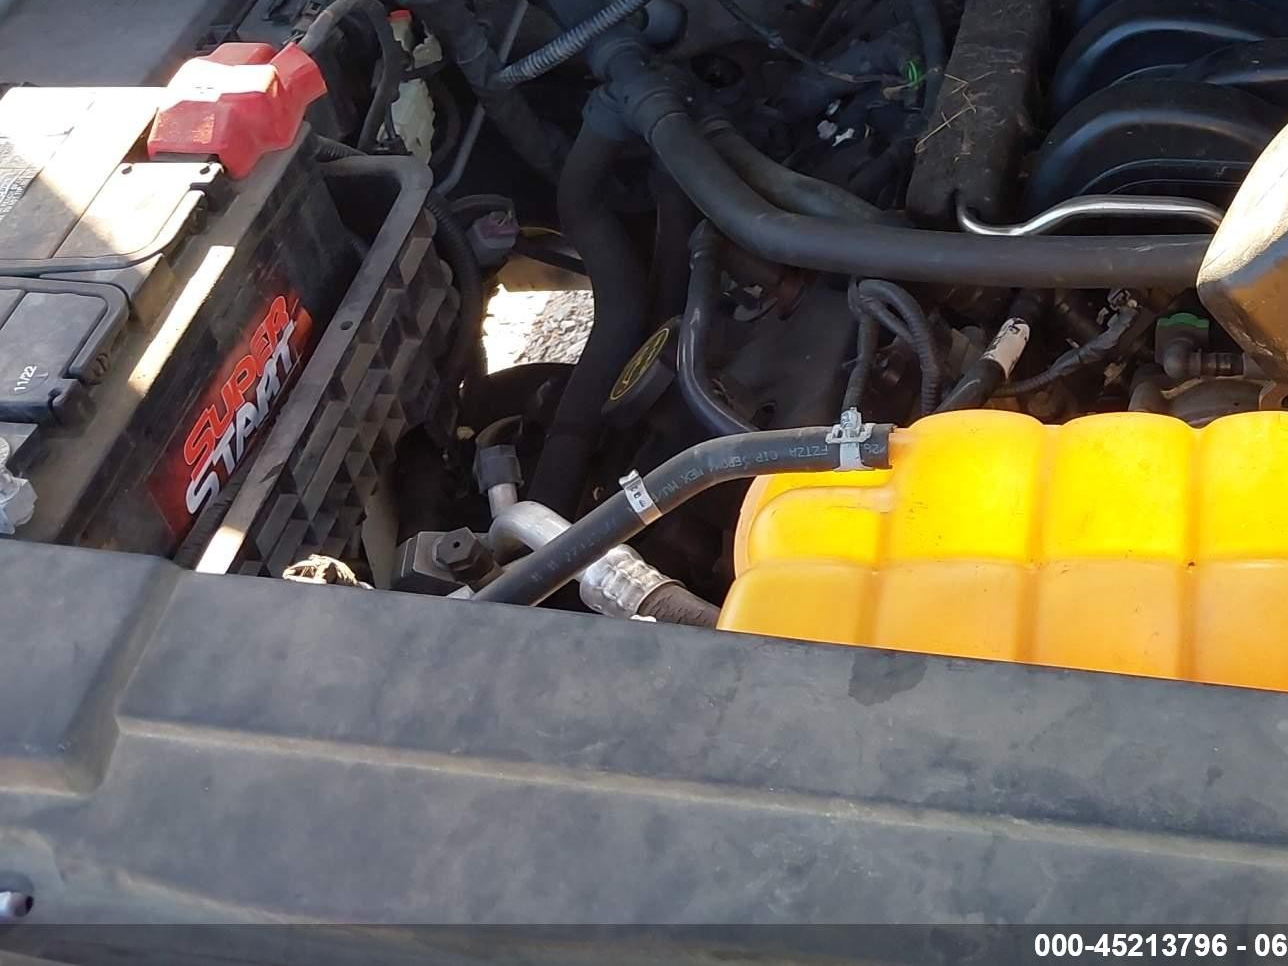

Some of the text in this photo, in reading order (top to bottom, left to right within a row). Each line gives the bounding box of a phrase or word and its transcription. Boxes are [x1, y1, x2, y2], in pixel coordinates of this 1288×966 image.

[13, 365, 38, 392] 11/22
[184, 296, 289, 482] SUPER
[186, 319, 297, 515] START
